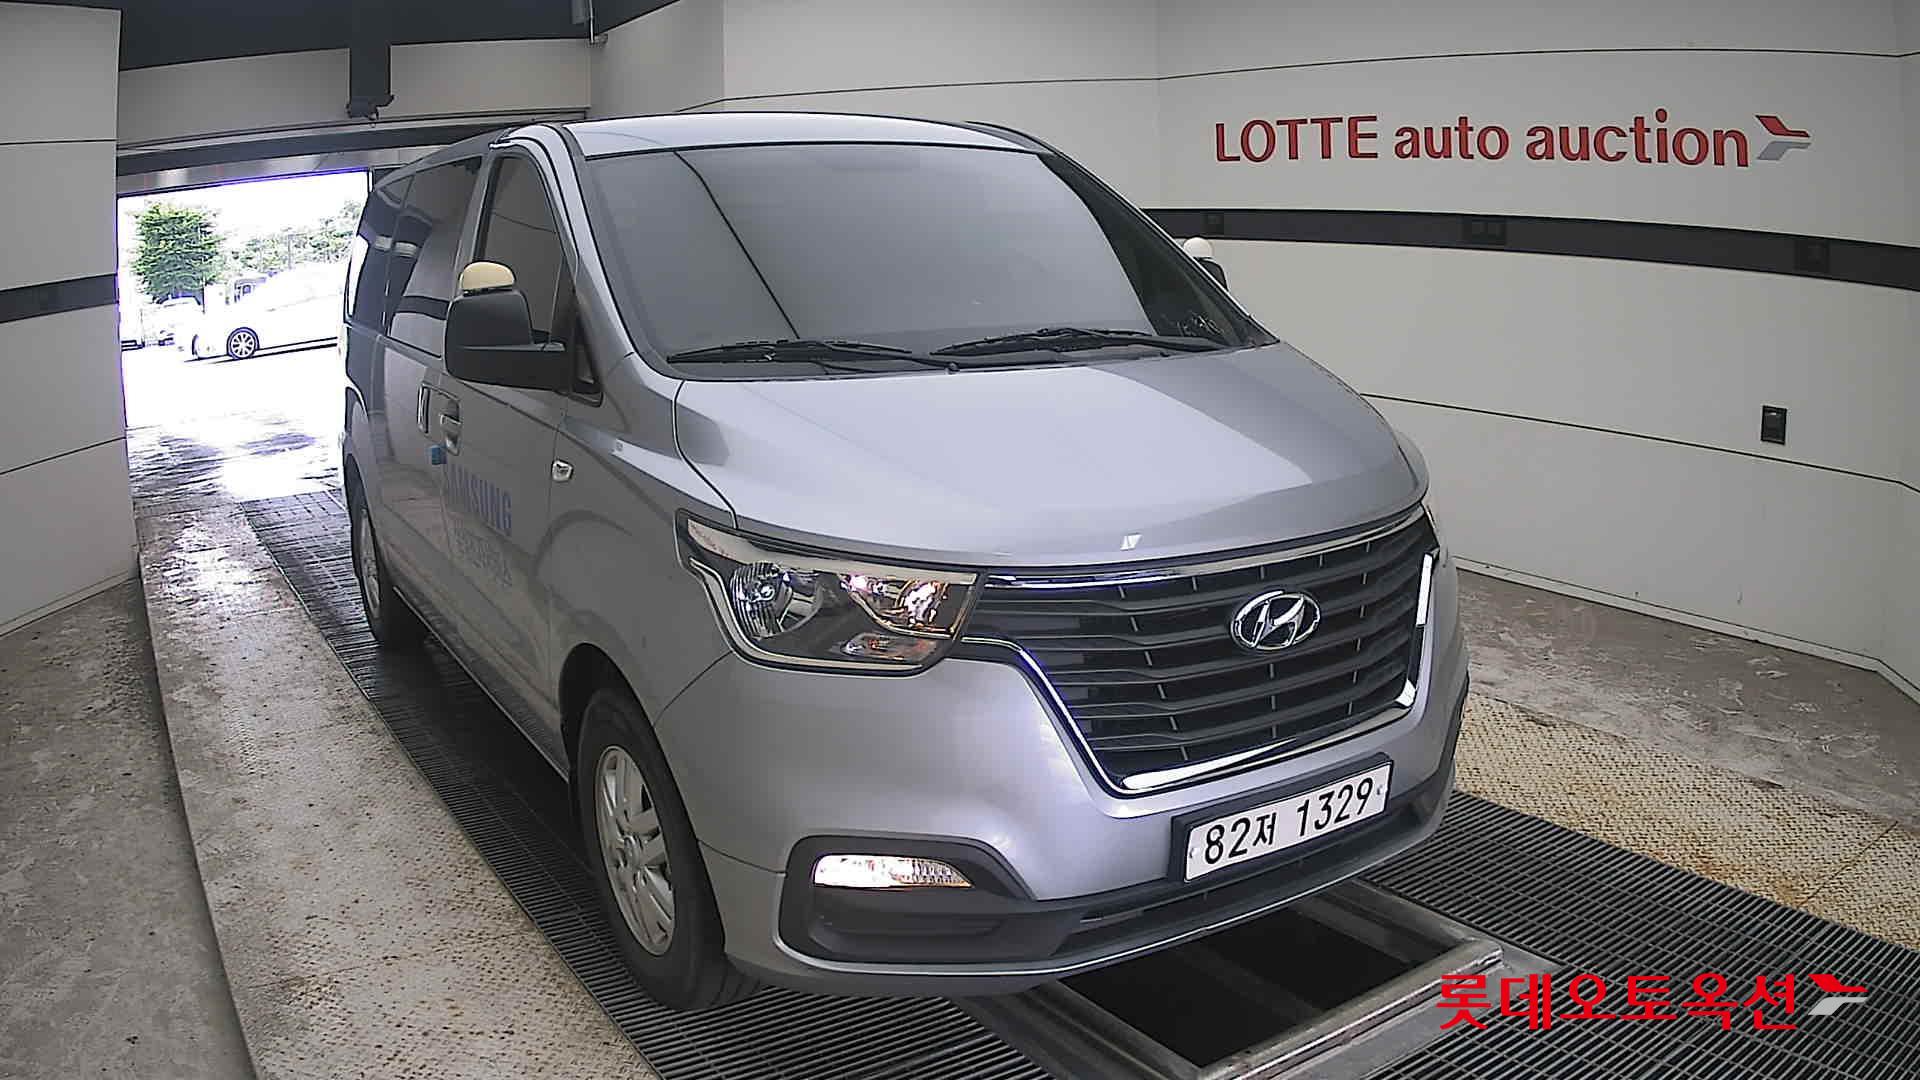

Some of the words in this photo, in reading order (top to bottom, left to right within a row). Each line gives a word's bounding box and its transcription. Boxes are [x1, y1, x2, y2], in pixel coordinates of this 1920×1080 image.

[1216, 116, 1378, 163] LOTTE
[1394, 116, 1509, 161] auto
[1526, 109, 1749, 167] auction
[444, 462, 513, 538] AMSUNG
[1204, 812, 1277, 865] 82저
[1297, 777, 1374, 837] 1329
